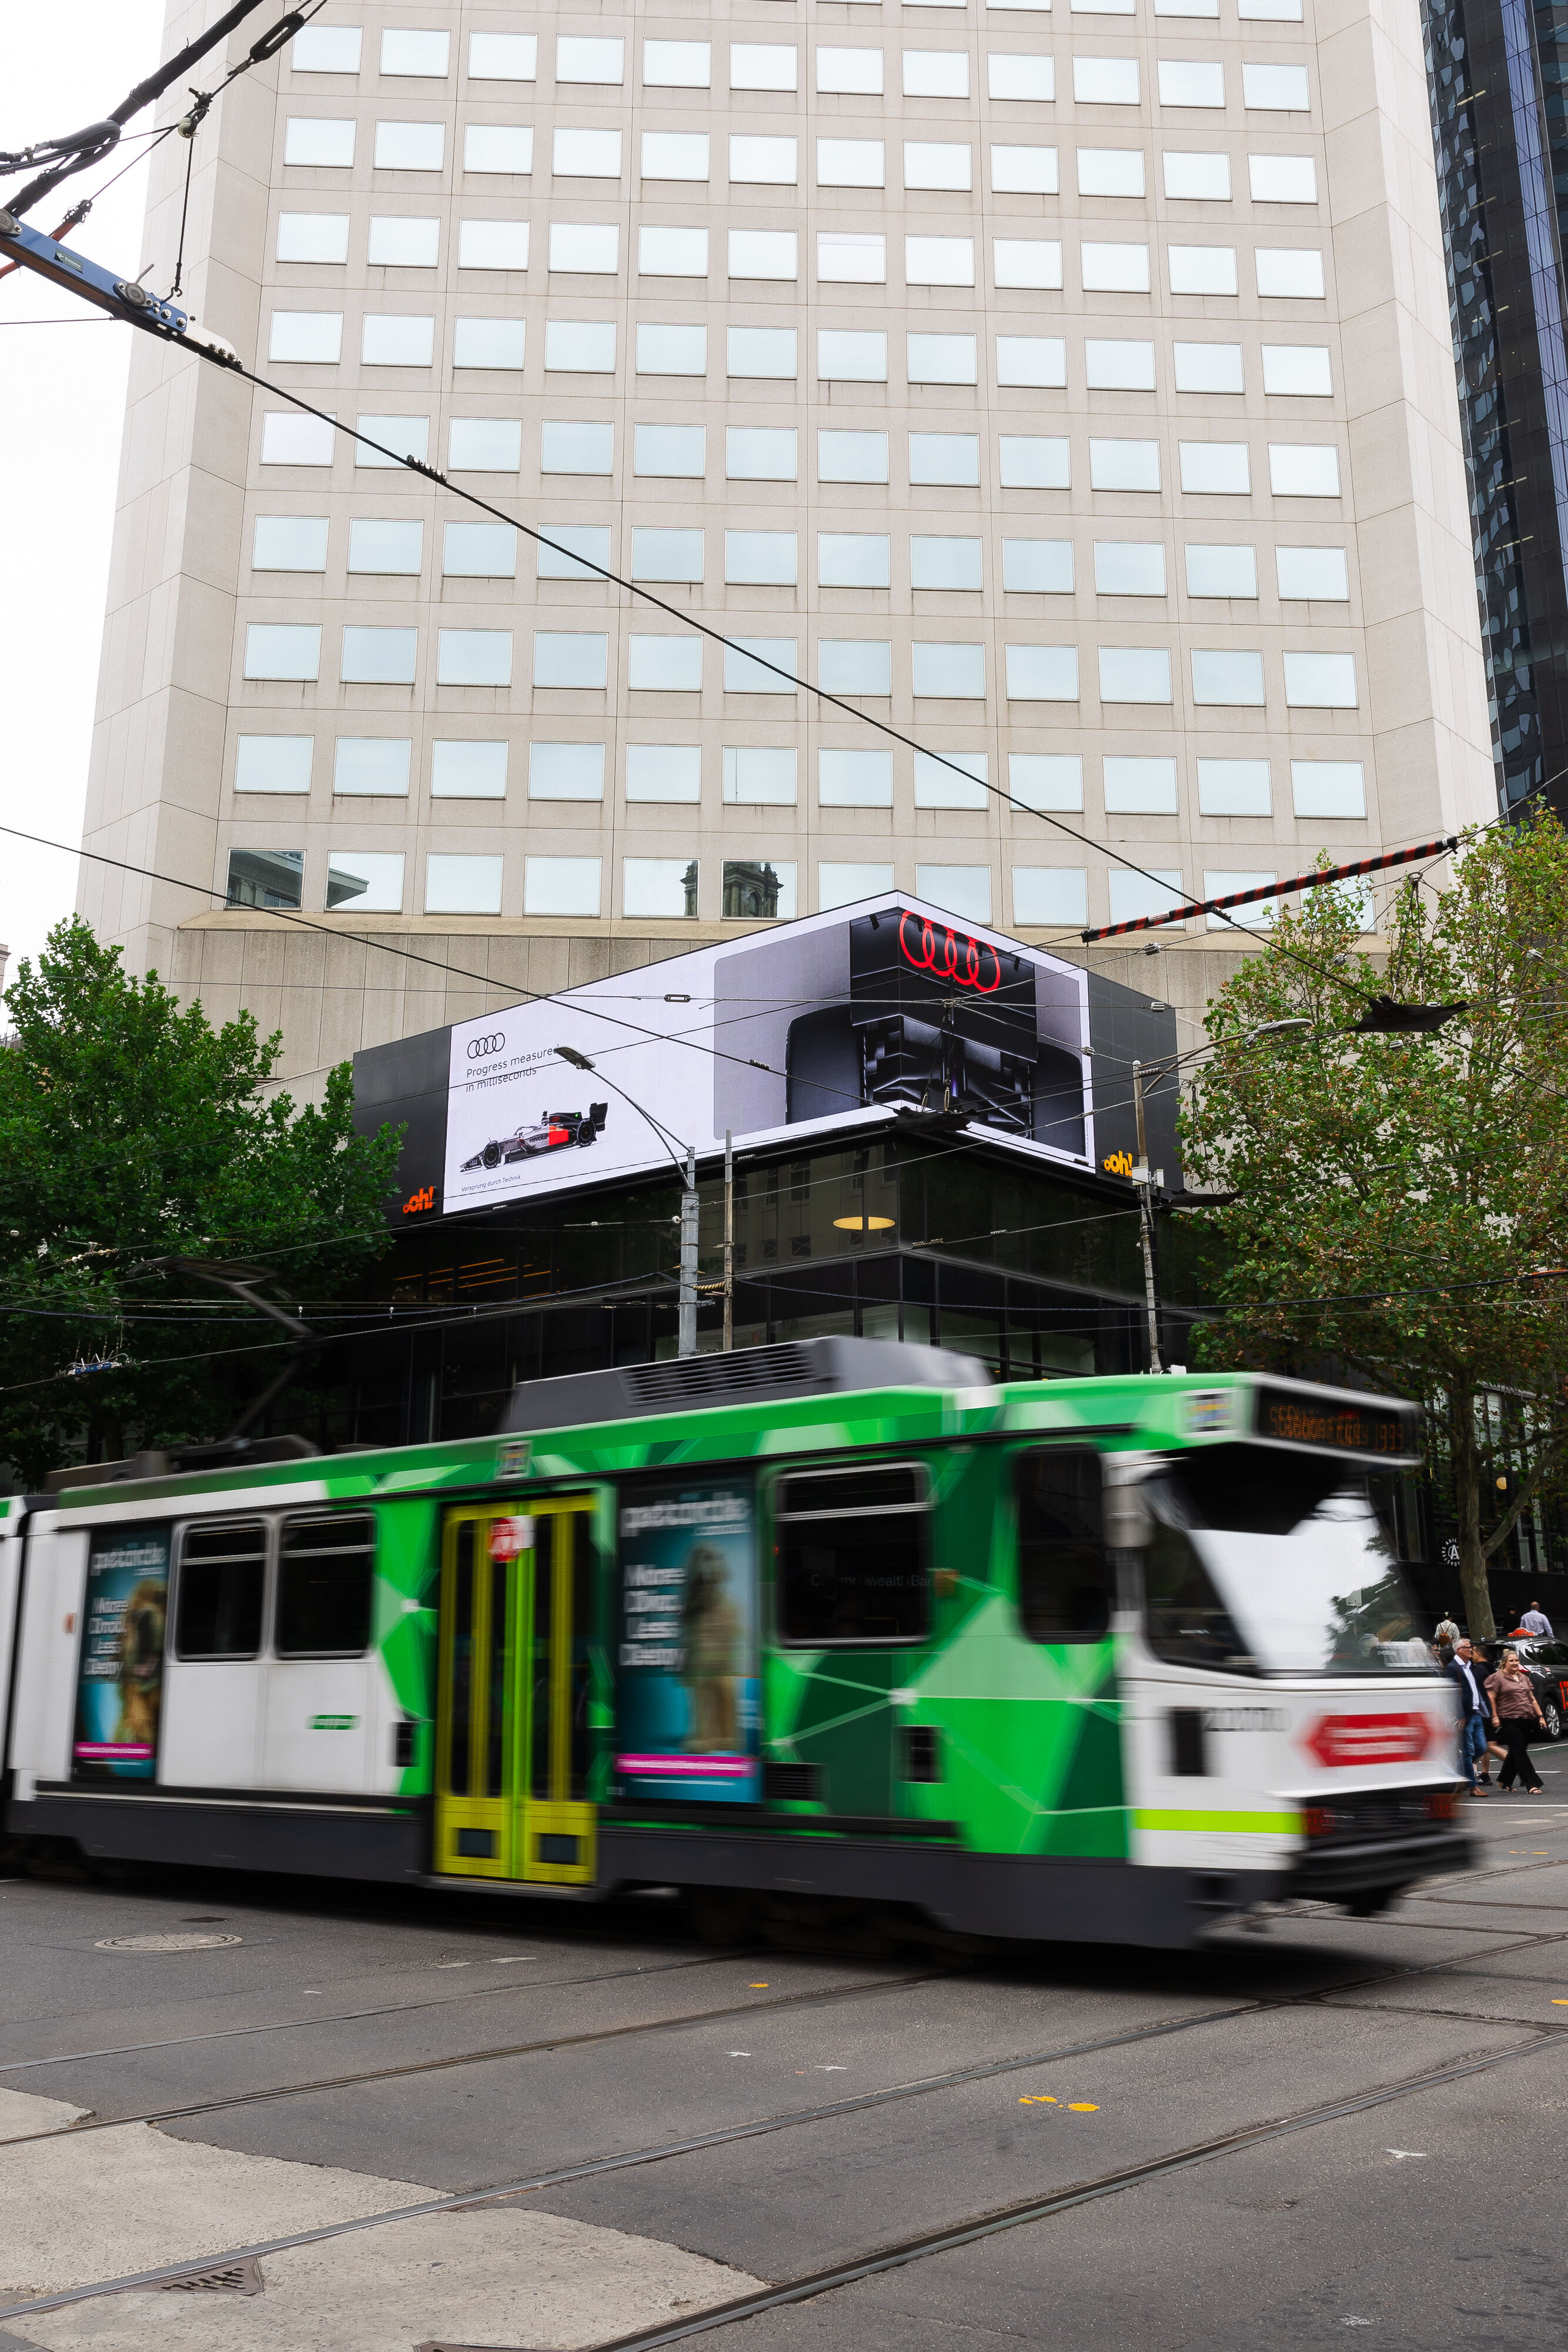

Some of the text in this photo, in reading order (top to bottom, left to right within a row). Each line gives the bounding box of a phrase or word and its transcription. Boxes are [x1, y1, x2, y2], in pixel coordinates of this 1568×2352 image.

[466, 1060, 507, 1078] Progress
[466, 1067, 537, 1093] in milliseconds
[461, 1182, 486, 1192] Vorsprung
[503, 1174, 521, 1184] Technik
